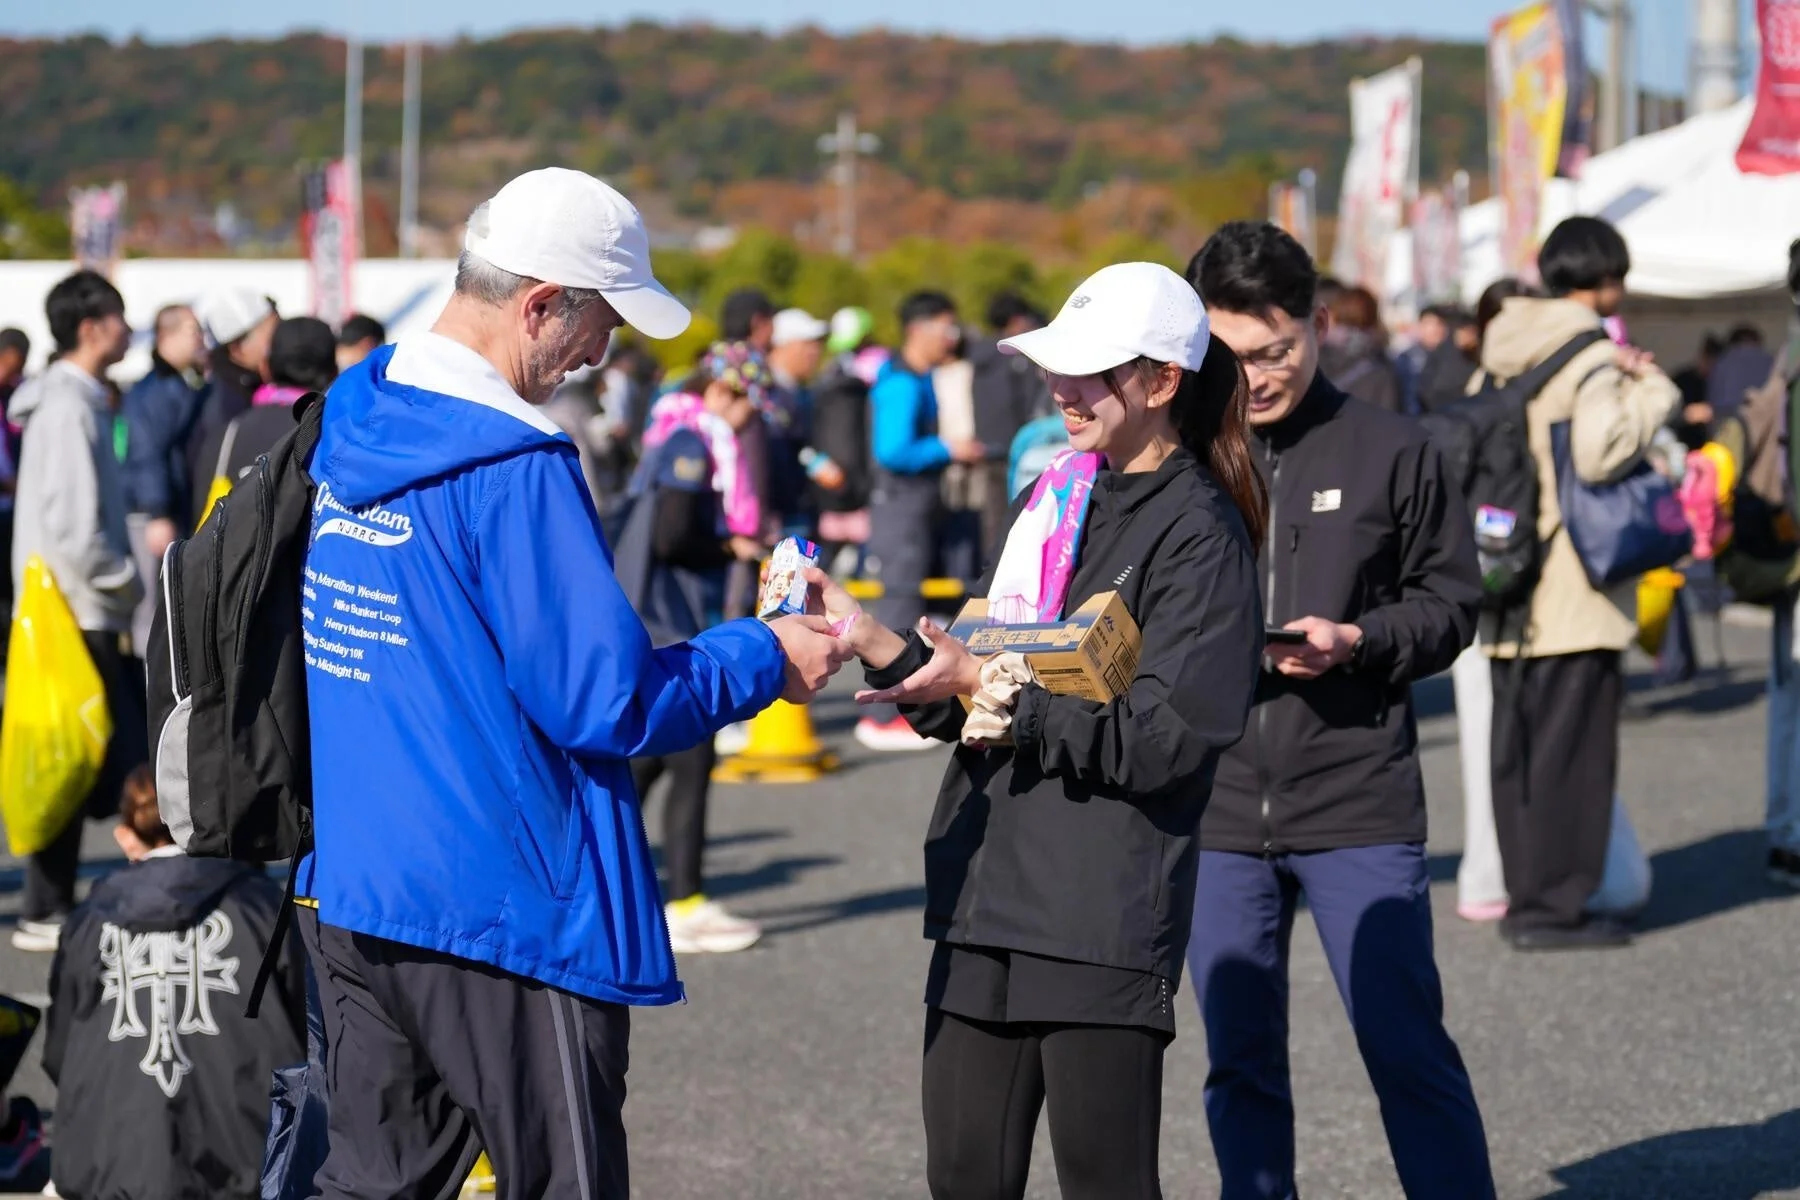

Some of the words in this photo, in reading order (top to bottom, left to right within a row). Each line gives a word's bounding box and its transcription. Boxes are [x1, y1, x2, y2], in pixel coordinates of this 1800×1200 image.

[337, 522, 377, 543] NJRRC
[317, 572, 355, 595] Marathon
[357, 585, 398, 605] Weekend
[351, 604, 379, 620] Bunker
[380, 610, 402, 626] Loop
[324, 616, 348, 635] Henry
[348, 624, 379, 641] Hudson
[380, 631, 387, 641] 8
[319, 637, 350, 658] Sunday
[350, 648, 365, 660] 10K
[317, 656, 352, 679] Midnight
[353, 668, 371, 683] Run
